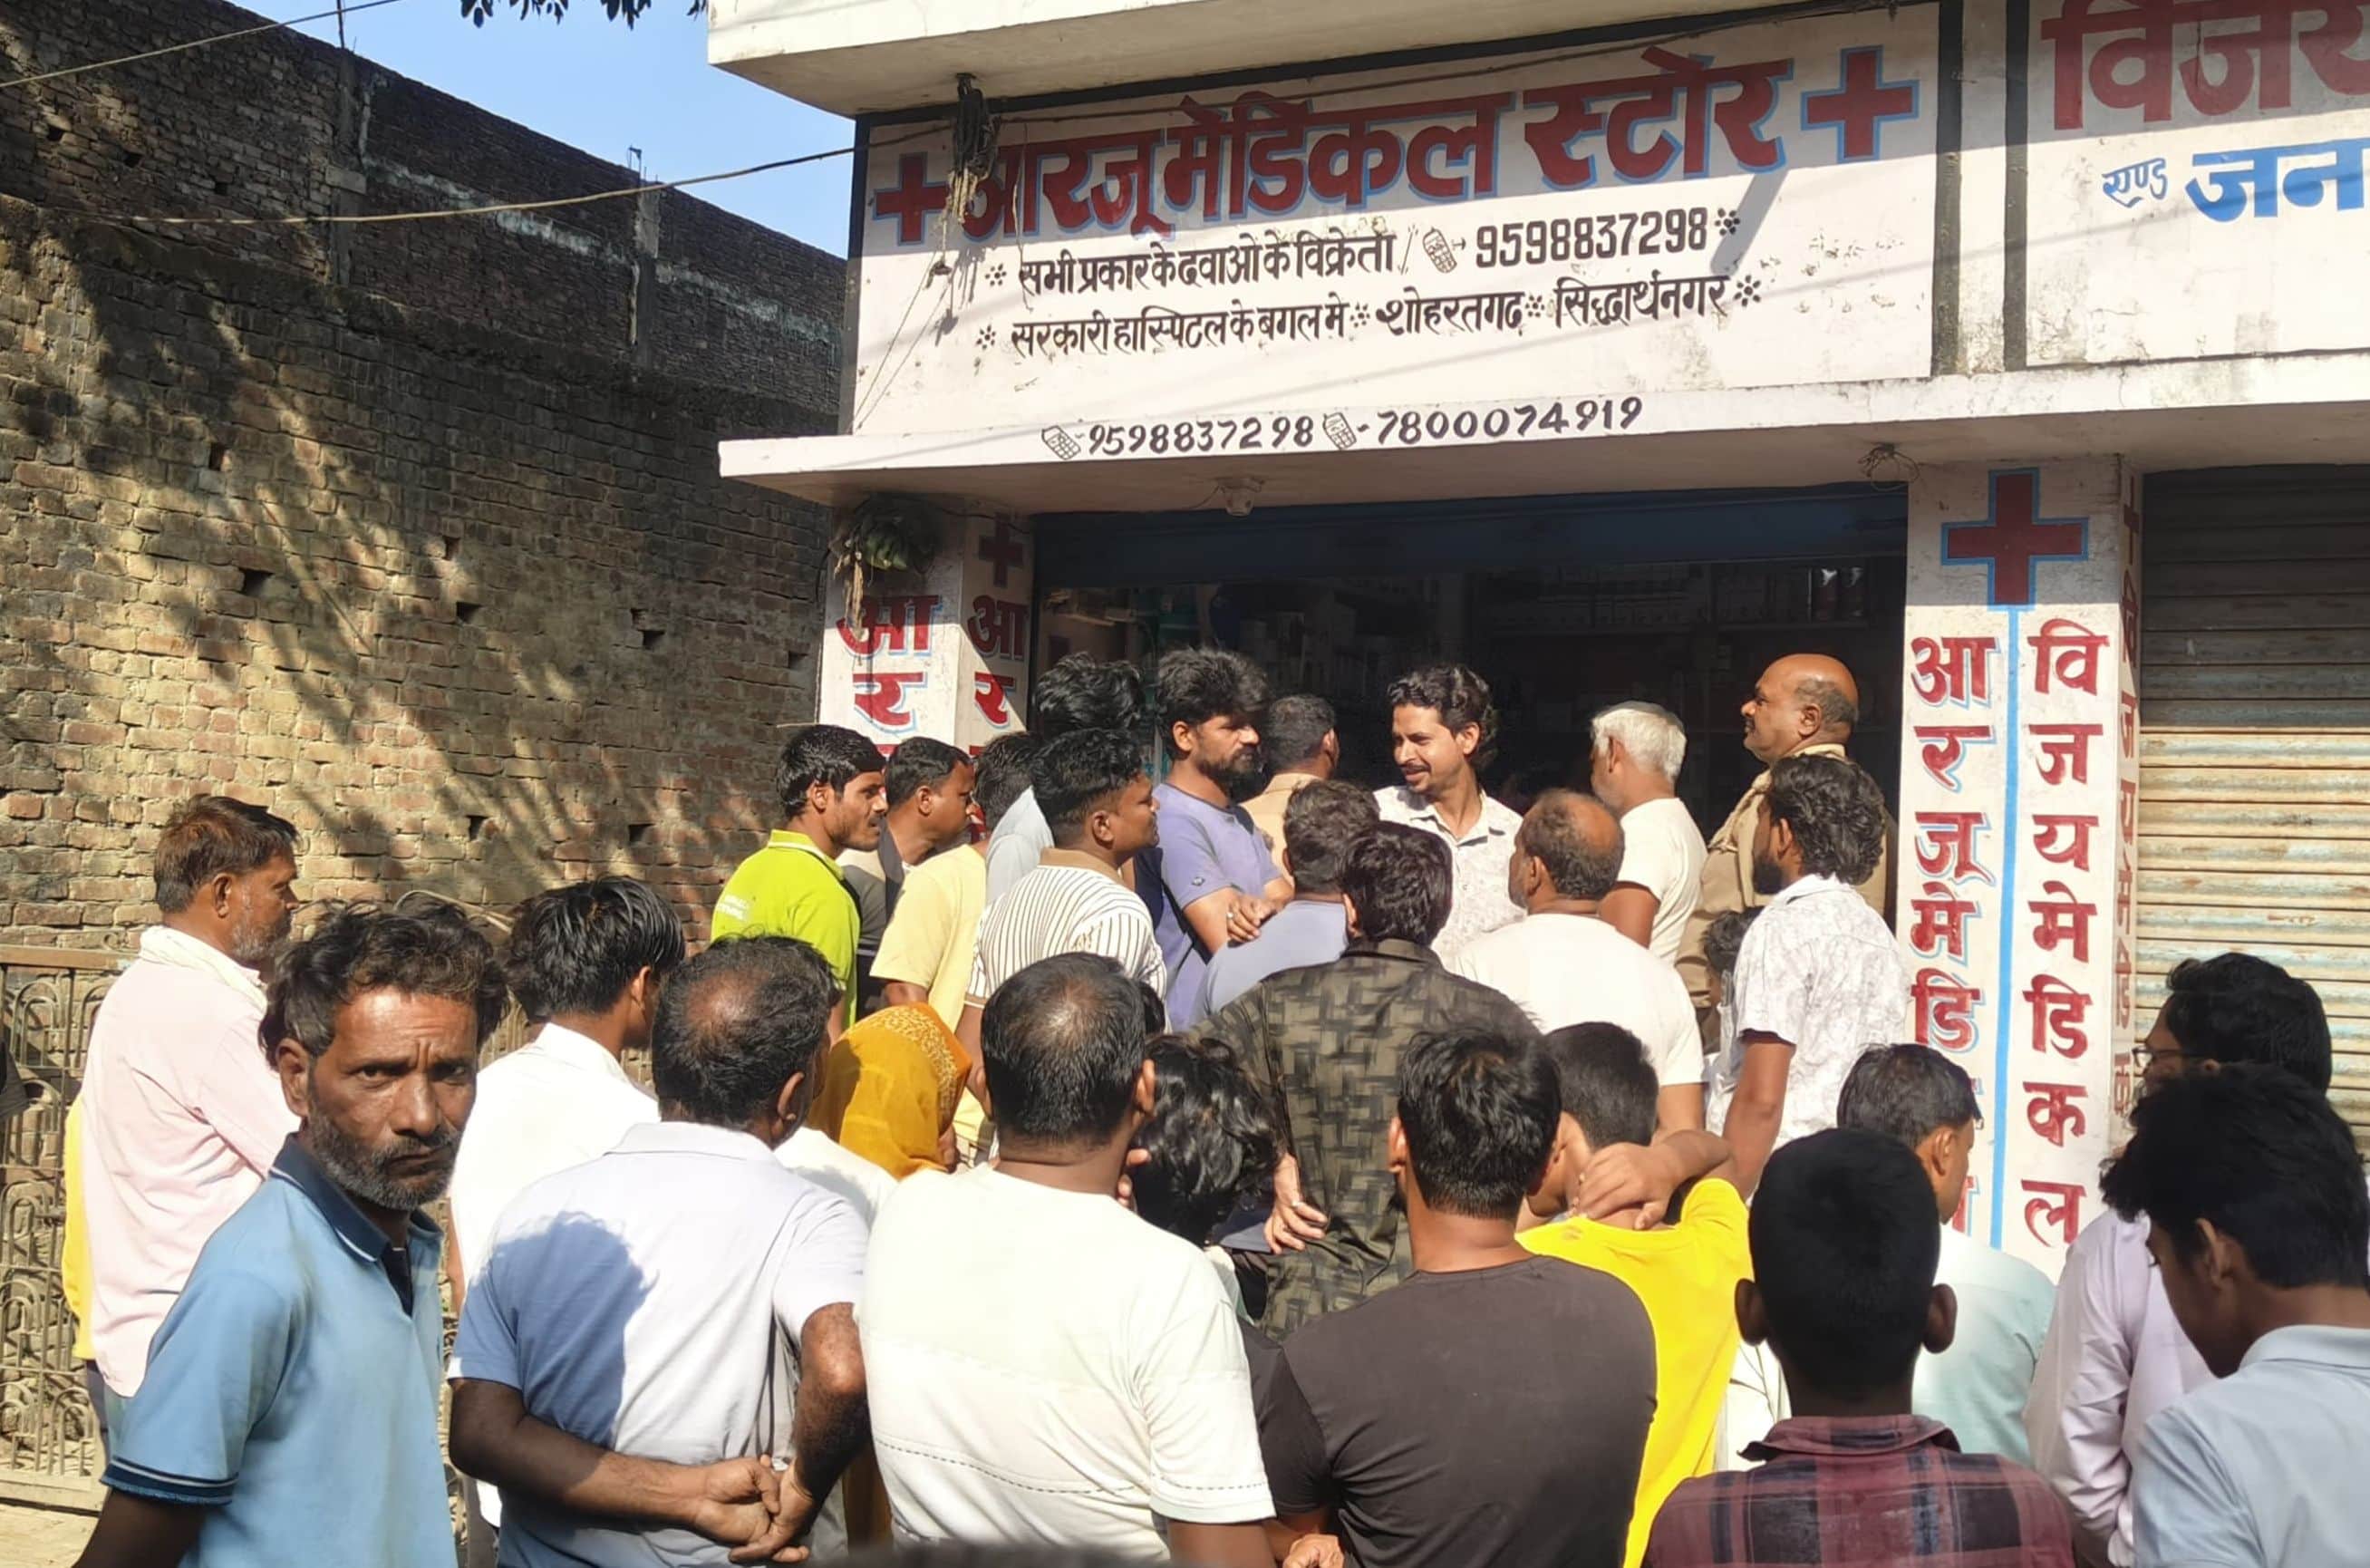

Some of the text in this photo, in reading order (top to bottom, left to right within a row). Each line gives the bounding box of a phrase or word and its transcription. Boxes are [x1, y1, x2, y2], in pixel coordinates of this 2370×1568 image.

[1523, 45, 1794, 192] स्टोर
[1019, 248, 1077, 296] सभी
[1078, 254, 1150, 295] प्रकार
[1151, 241, 1177, 288] के
[1262, 228, 1291, 280] के
[1475, 207, 1708, 269] 9598837298
[1011, 309, 1112, 359] सरकारी
[1230, 298, 1255, 343] के
[1256, 304, 1323, 342] बगल
